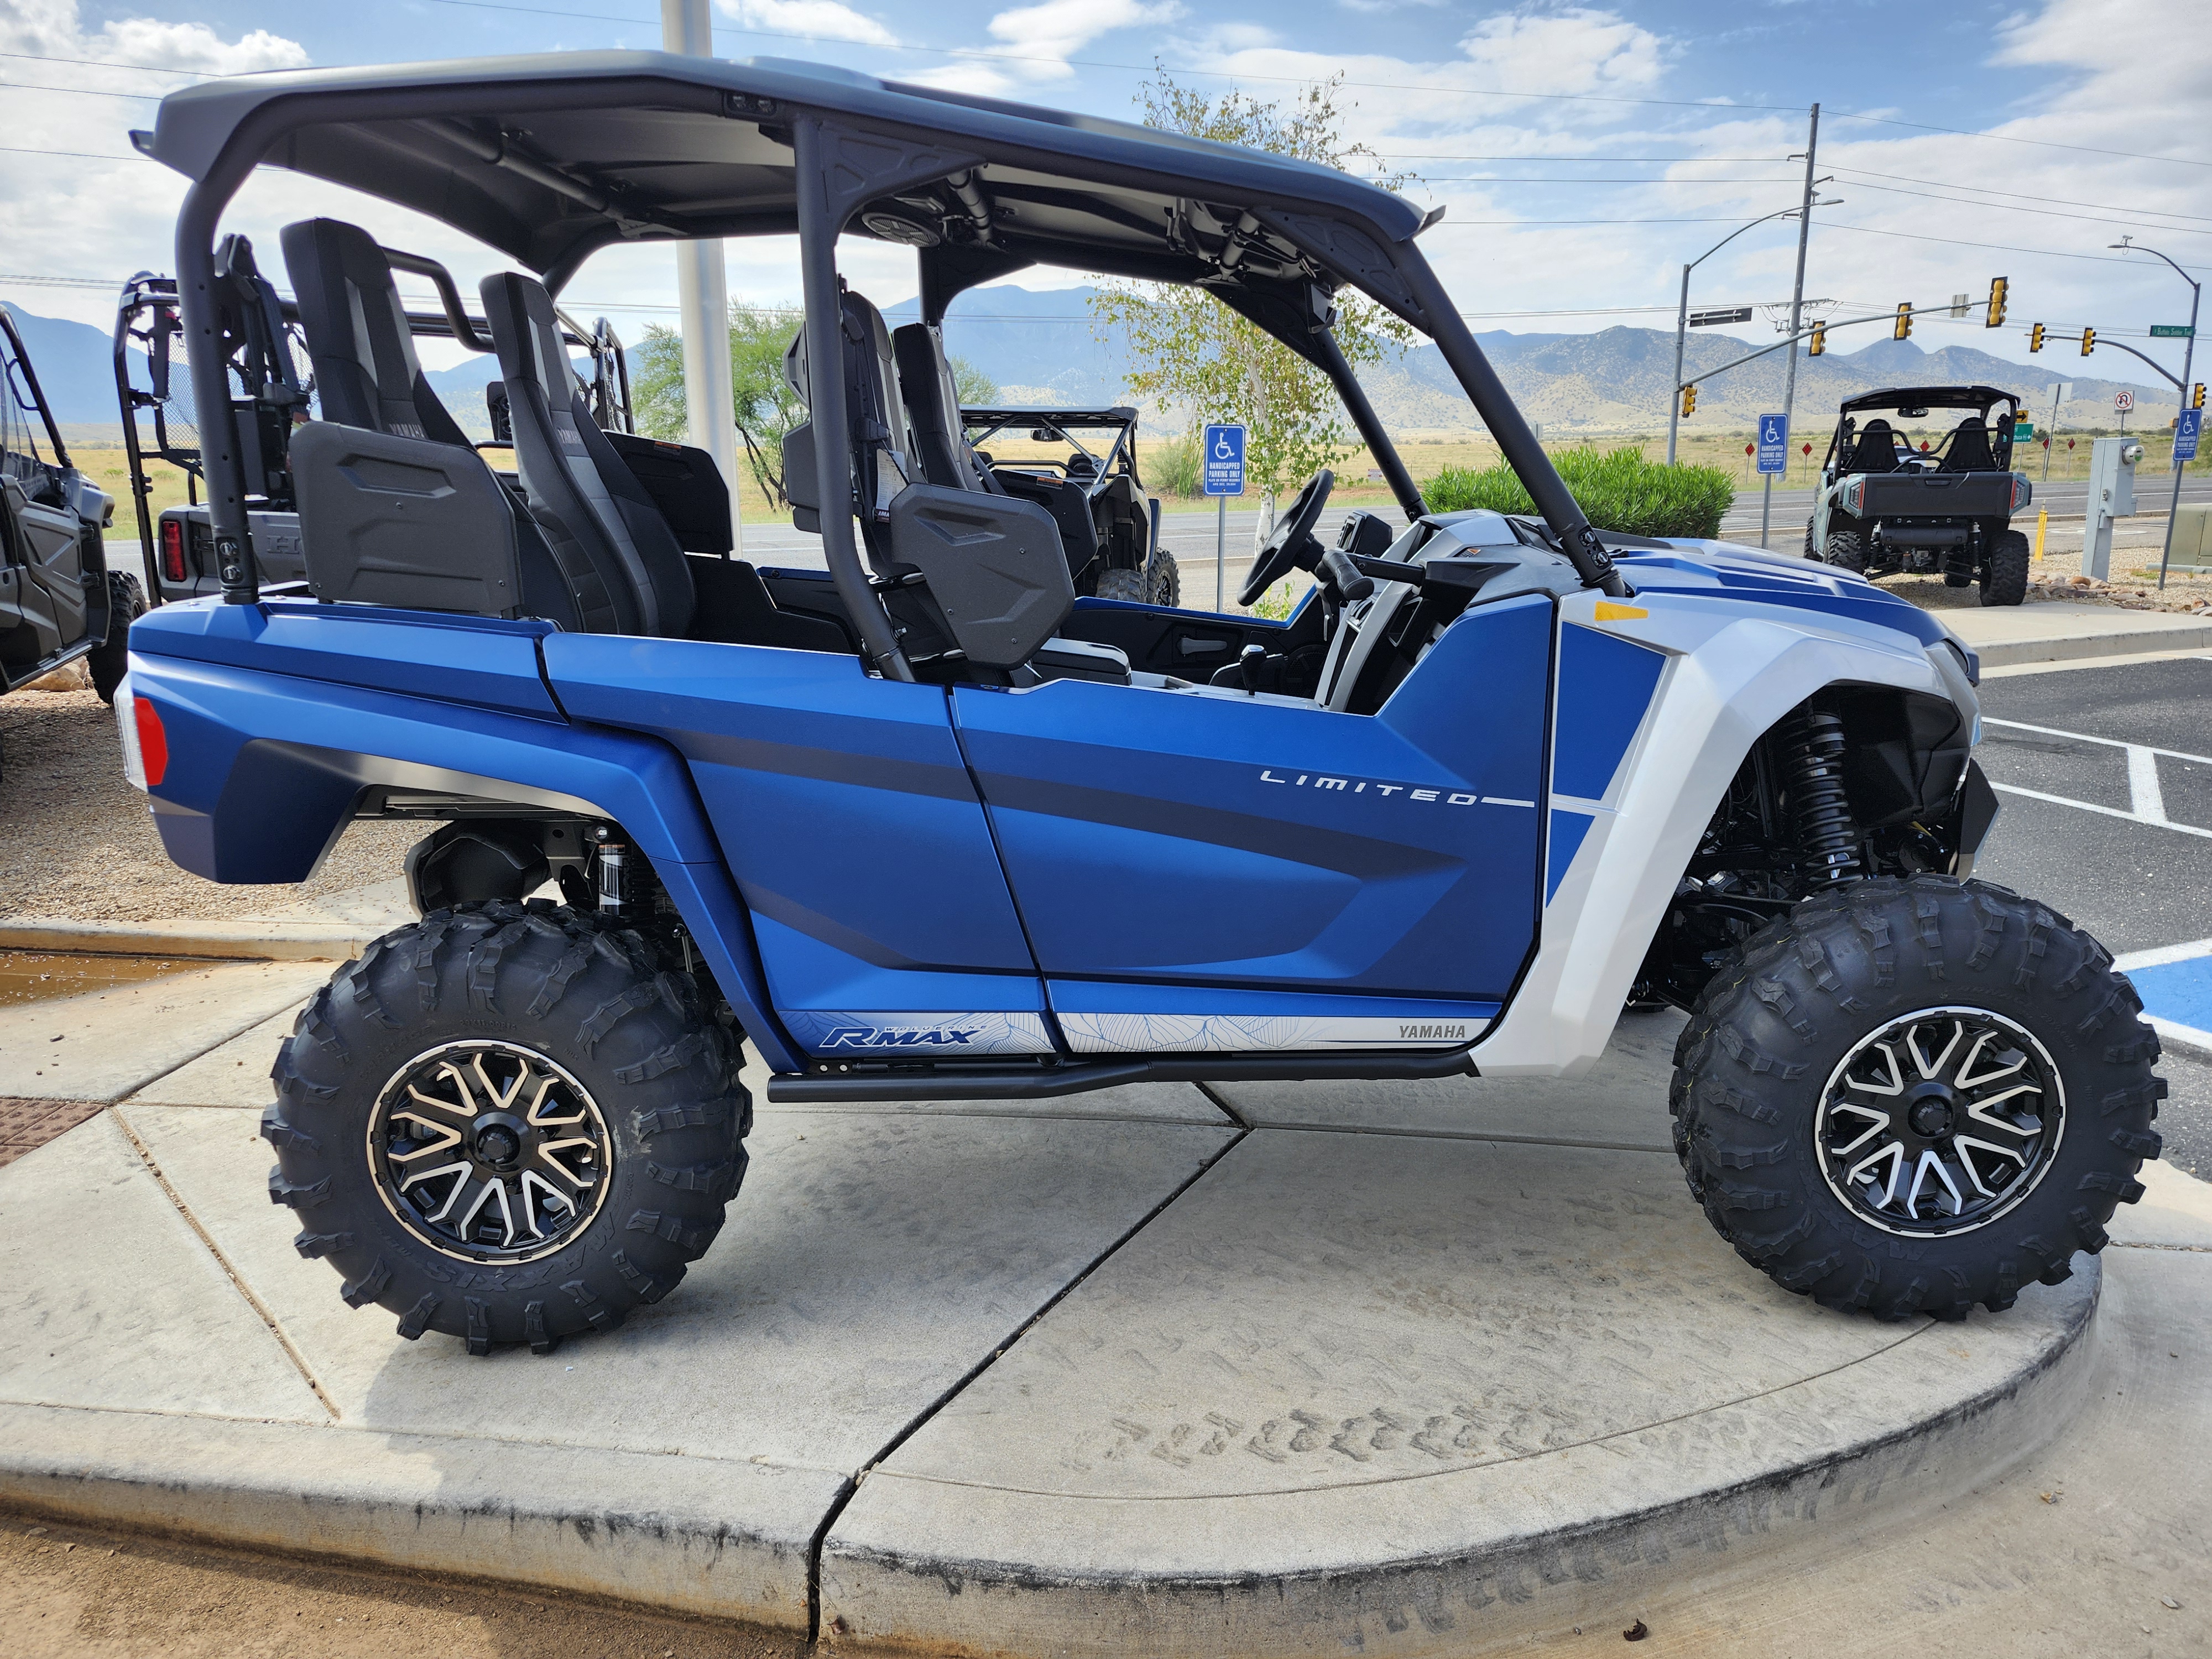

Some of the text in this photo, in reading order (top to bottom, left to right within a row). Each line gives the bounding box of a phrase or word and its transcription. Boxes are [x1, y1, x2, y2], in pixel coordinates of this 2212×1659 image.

[1260, 770, 1478, 806] LIMITED
[818, 1026, 982, 1048] RMAX
[1399, 1025, 1465, 1038] YAMAHA
[420, 1212, 624, 1292] MAXXIS
